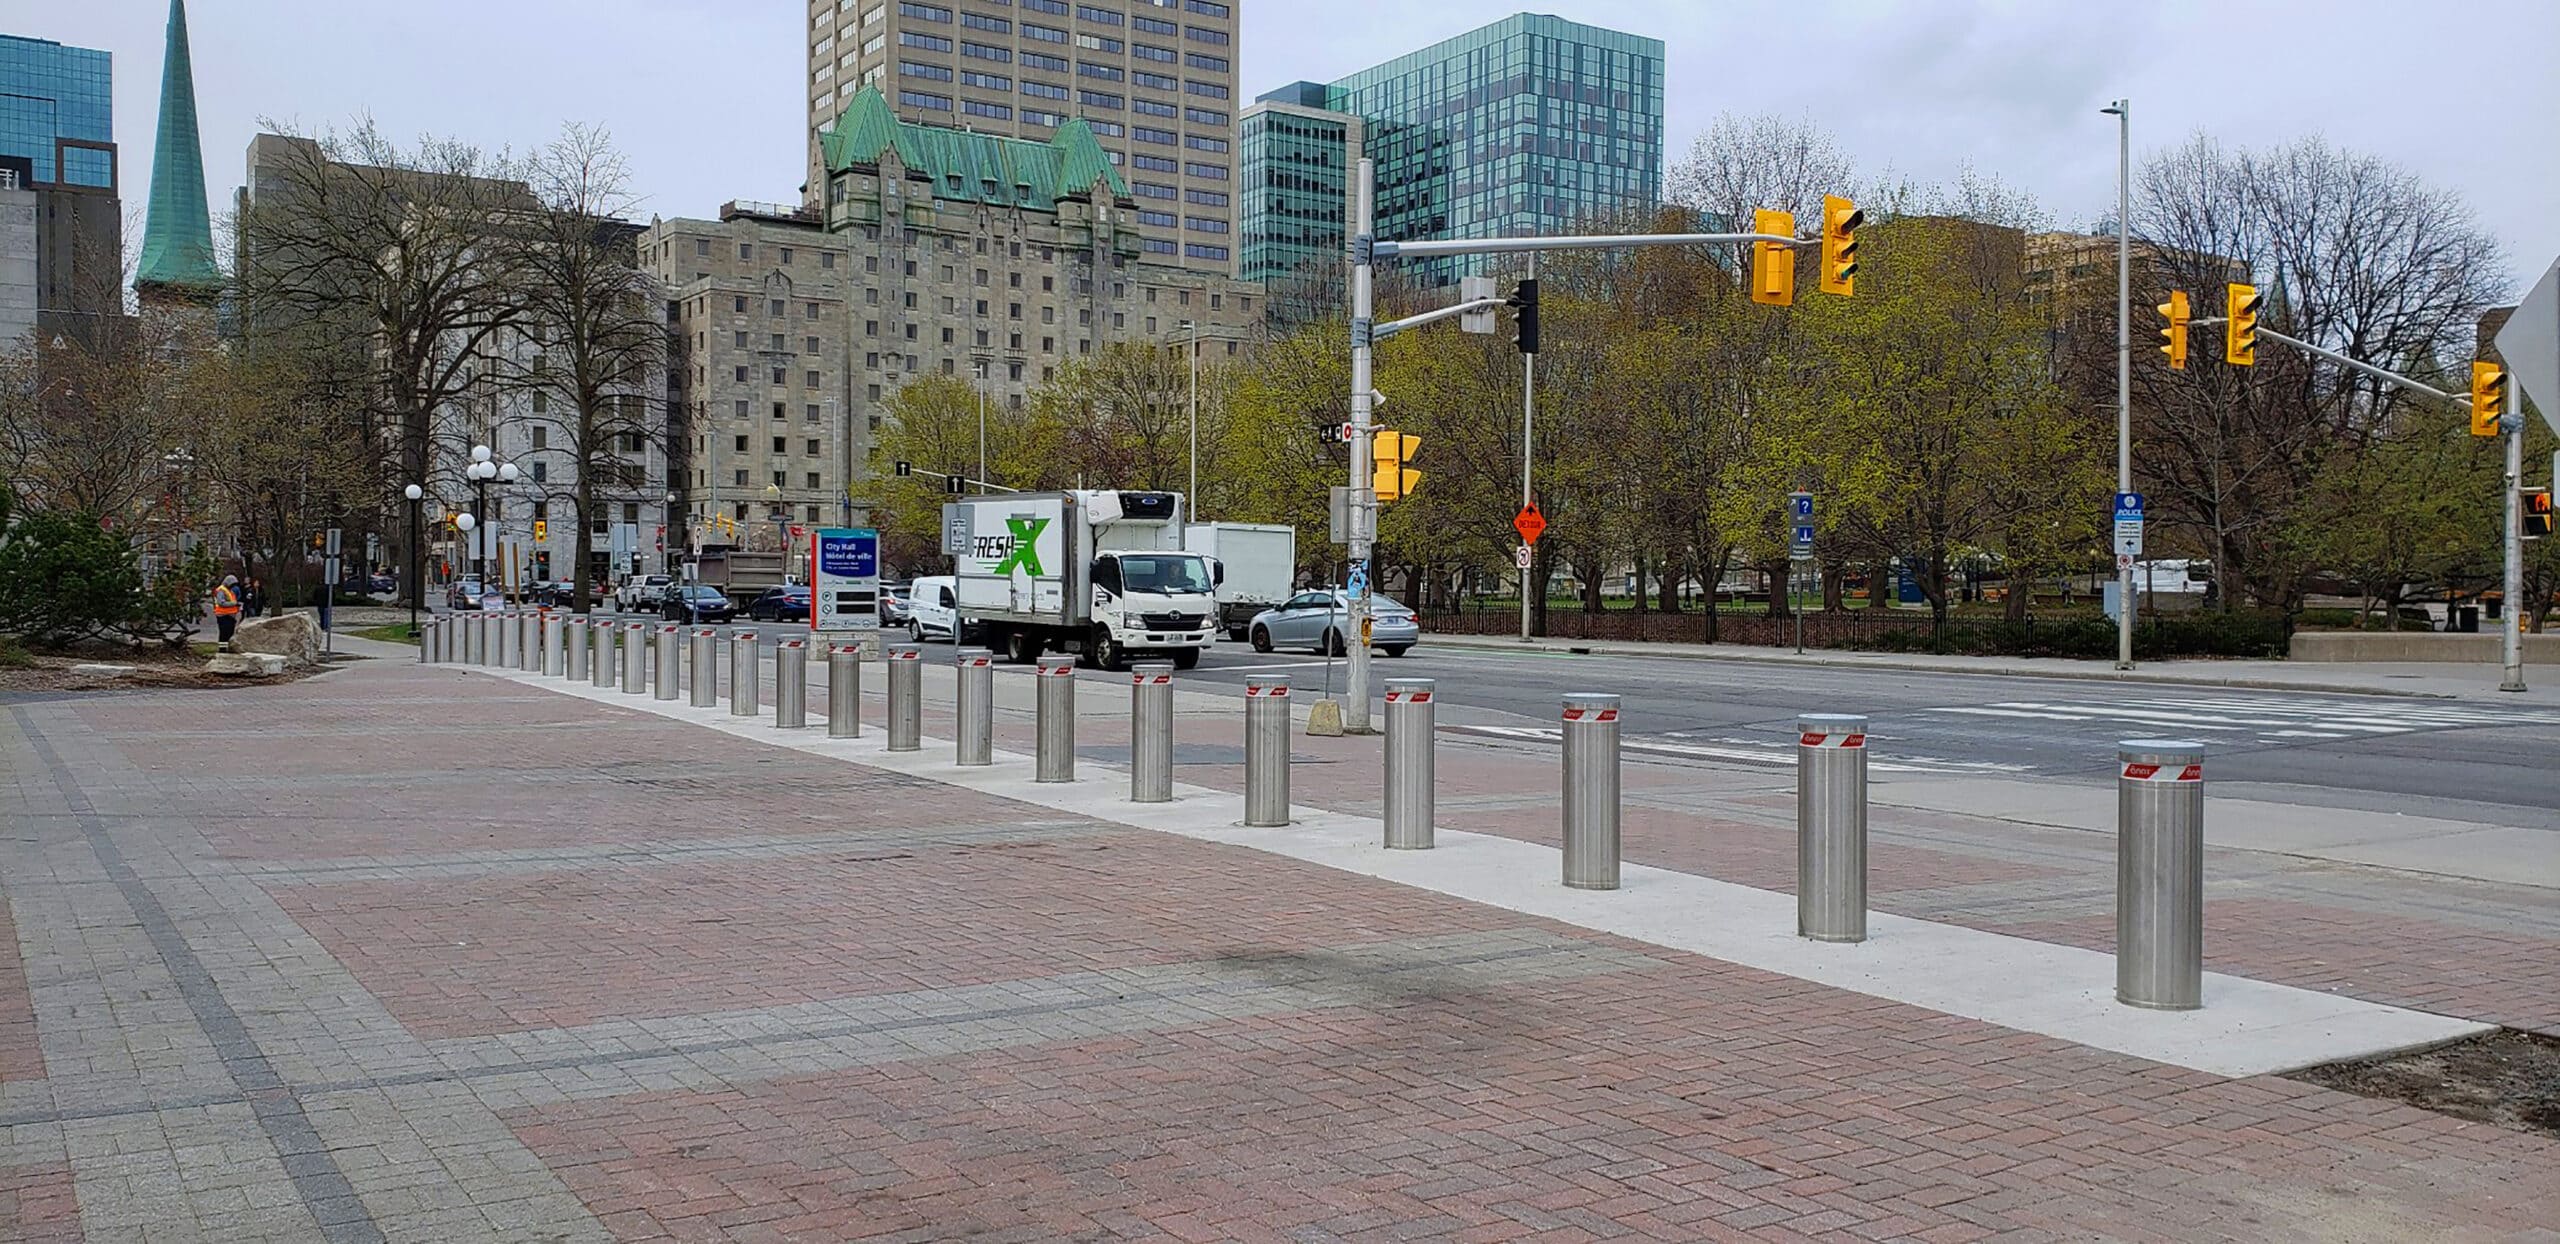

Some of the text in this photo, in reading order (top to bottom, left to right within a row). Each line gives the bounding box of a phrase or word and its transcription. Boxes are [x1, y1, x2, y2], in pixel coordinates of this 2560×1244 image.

[826, 543, 840, 551] City
[826, 552, 872, 560] Hôtel de ville
